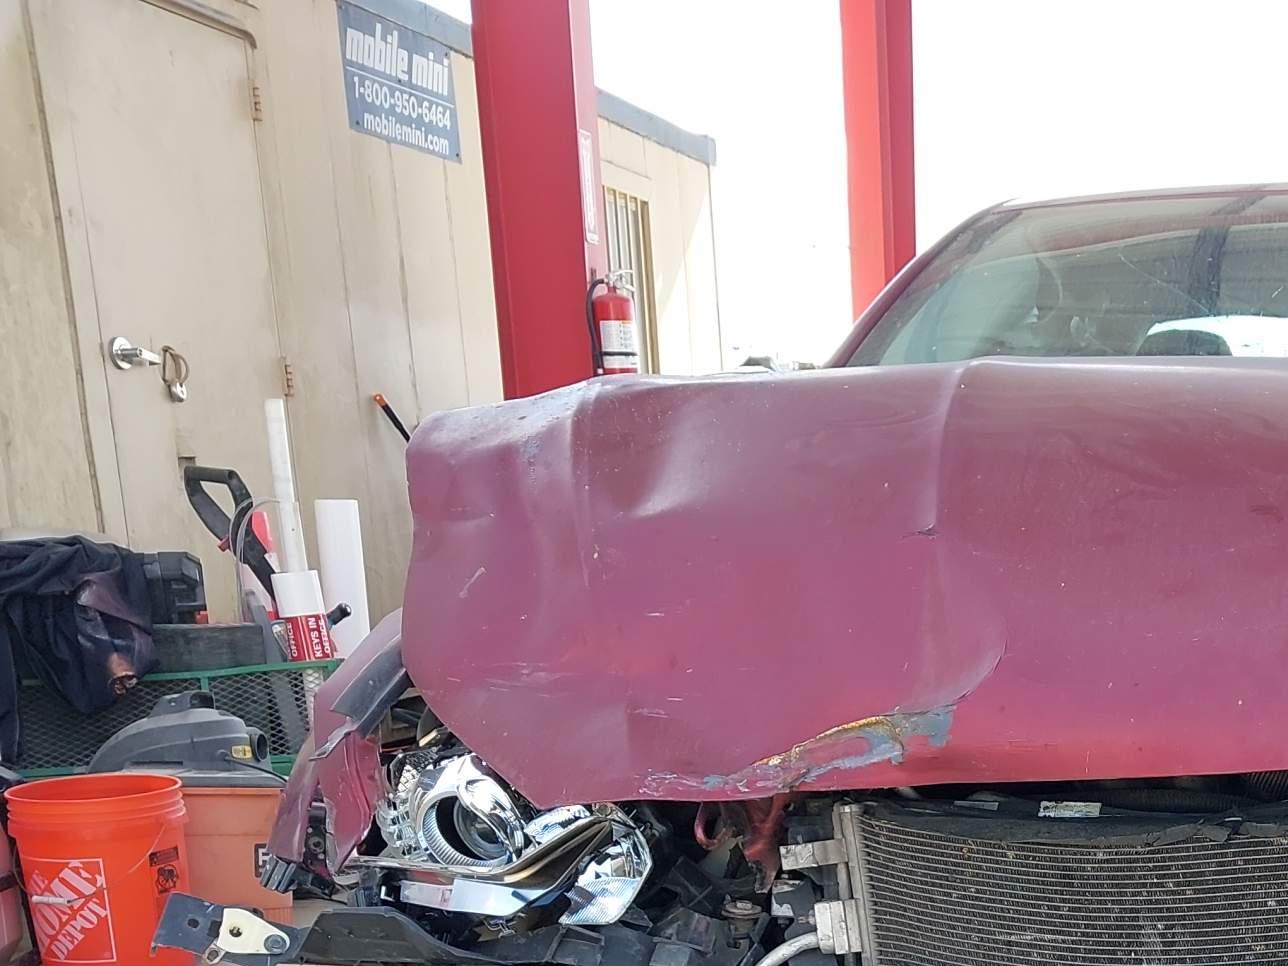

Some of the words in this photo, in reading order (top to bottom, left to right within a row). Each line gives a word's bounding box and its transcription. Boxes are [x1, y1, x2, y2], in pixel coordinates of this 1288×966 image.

[345, 23, 409, 81] mobile
[412, 52, 449, 96] mini
[353, 76, 452, 130] 1-800-950-6464
[363, 113, 450, 155] mobilemini.com
[307, 617, 318, 629] IN
[310, 631, 323, 658] KEYS
[50, 897, 108, 961] DEPOT
